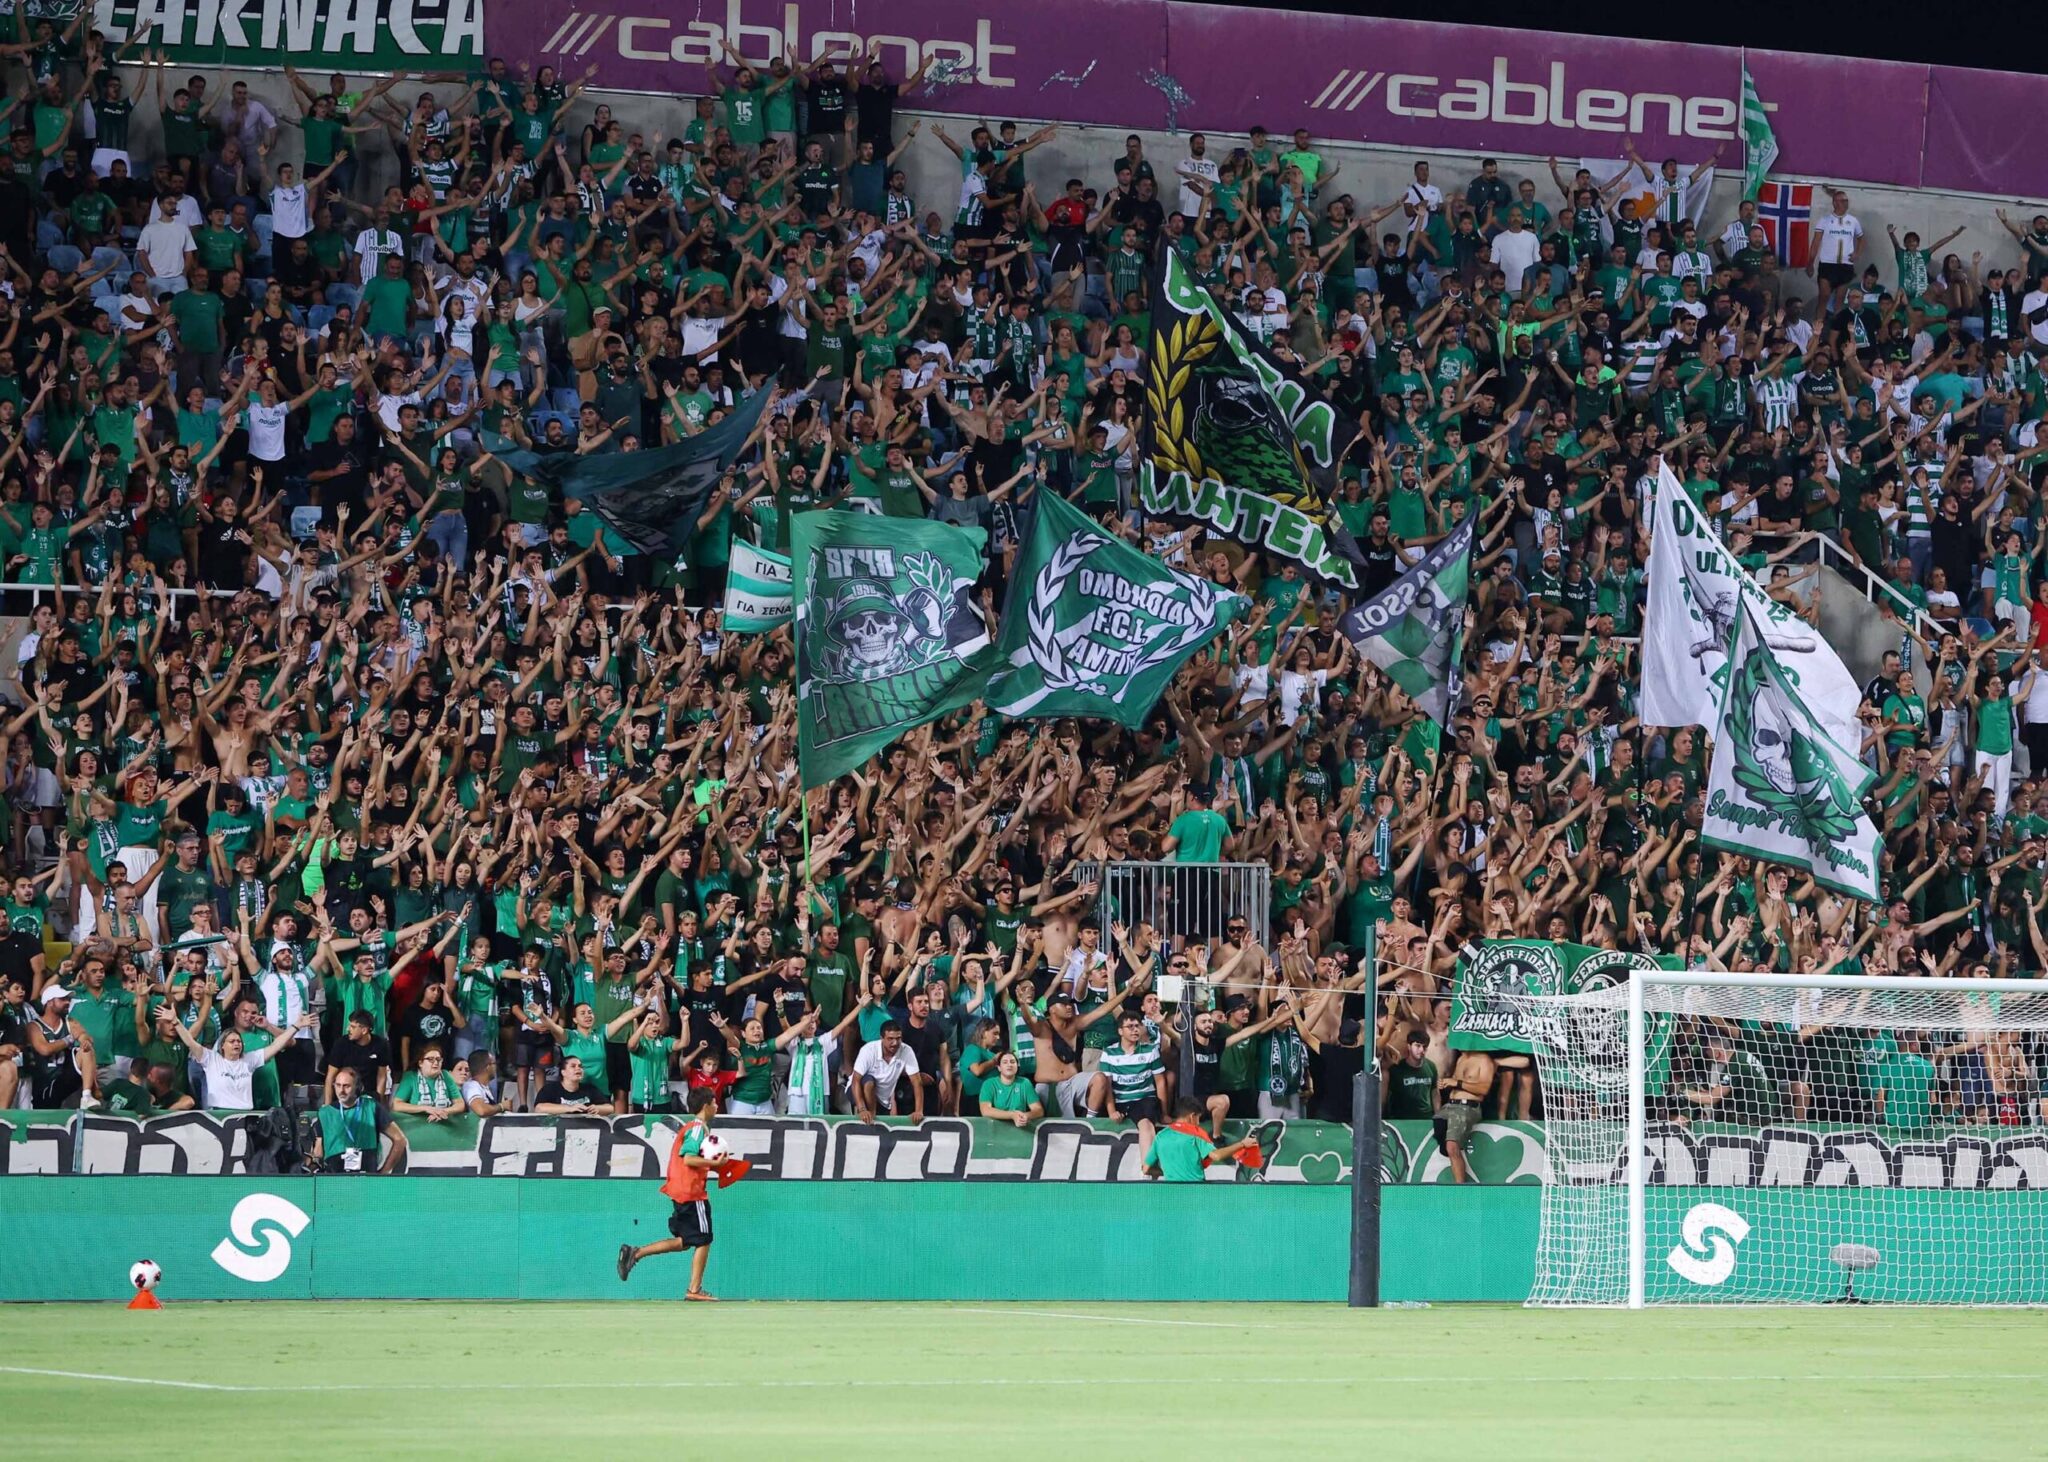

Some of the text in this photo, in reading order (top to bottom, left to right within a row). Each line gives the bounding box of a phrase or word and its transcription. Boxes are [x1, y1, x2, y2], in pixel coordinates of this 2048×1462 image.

[617, 0, 1016, 87] cablenet
[1387, 56, 1778, 140] cablene
[369, 244, 396, 253] novibet
[755, 561, 777, 578] ΓΙΑ
[737, 600, 755, 614] ΓΙΑ
[1078, 568, 1193, 626] OMONOIA
[1707, 788, 1778, 834] Semper
[1573, 953, 1626, 988] SEMPER
[1455, 1013, 1515, 1032] LARNACA
